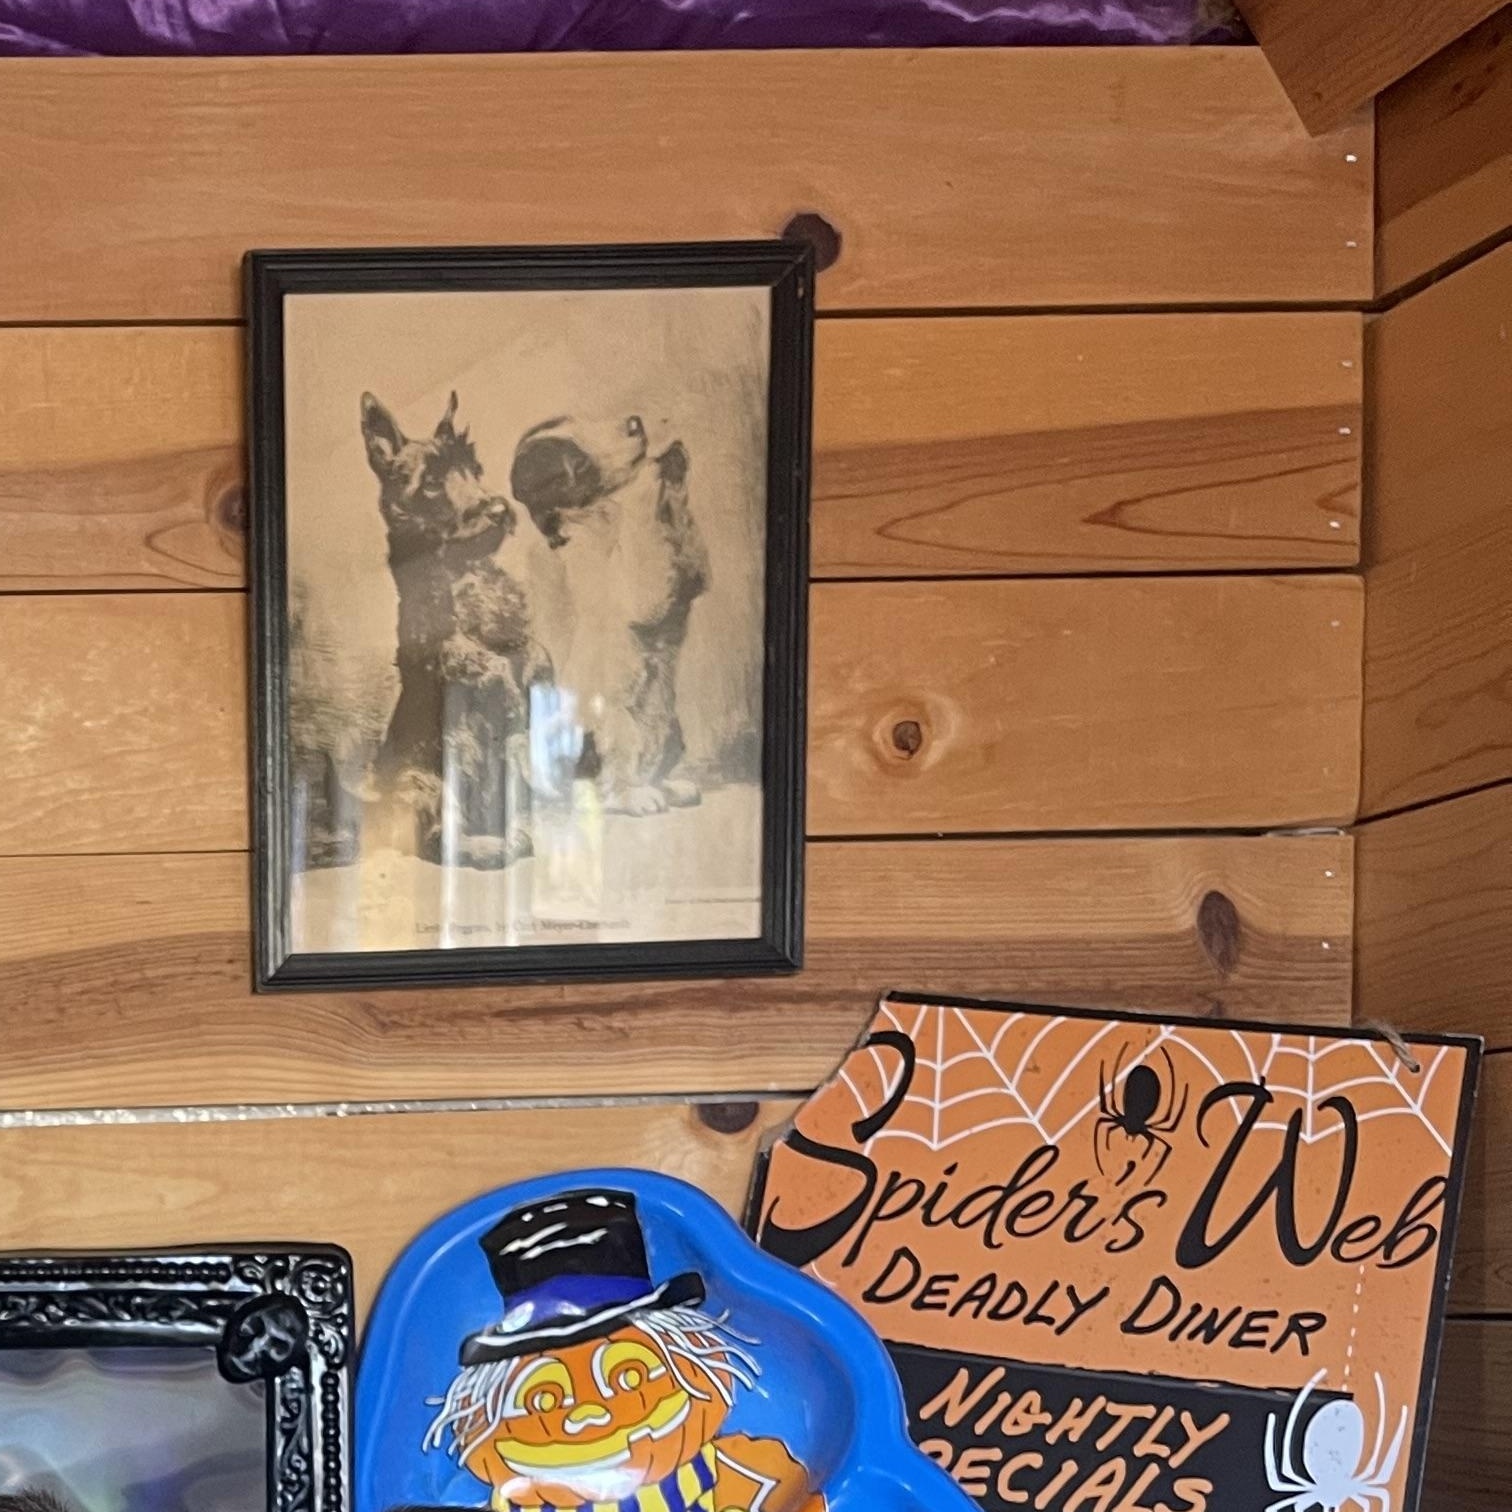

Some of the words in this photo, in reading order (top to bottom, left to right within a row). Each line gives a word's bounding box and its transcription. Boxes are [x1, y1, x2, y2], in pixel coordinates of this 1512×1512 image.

[756, 1030, 1167, 1270] Spider's
[1174, 1077, 1449, 1270] Web
[861, 1247, 1111, 1336] DEADLY
[1120, 1274, 1328, 1356] DINER
[919, 1366, 1231, 1469] NIGHTLY
